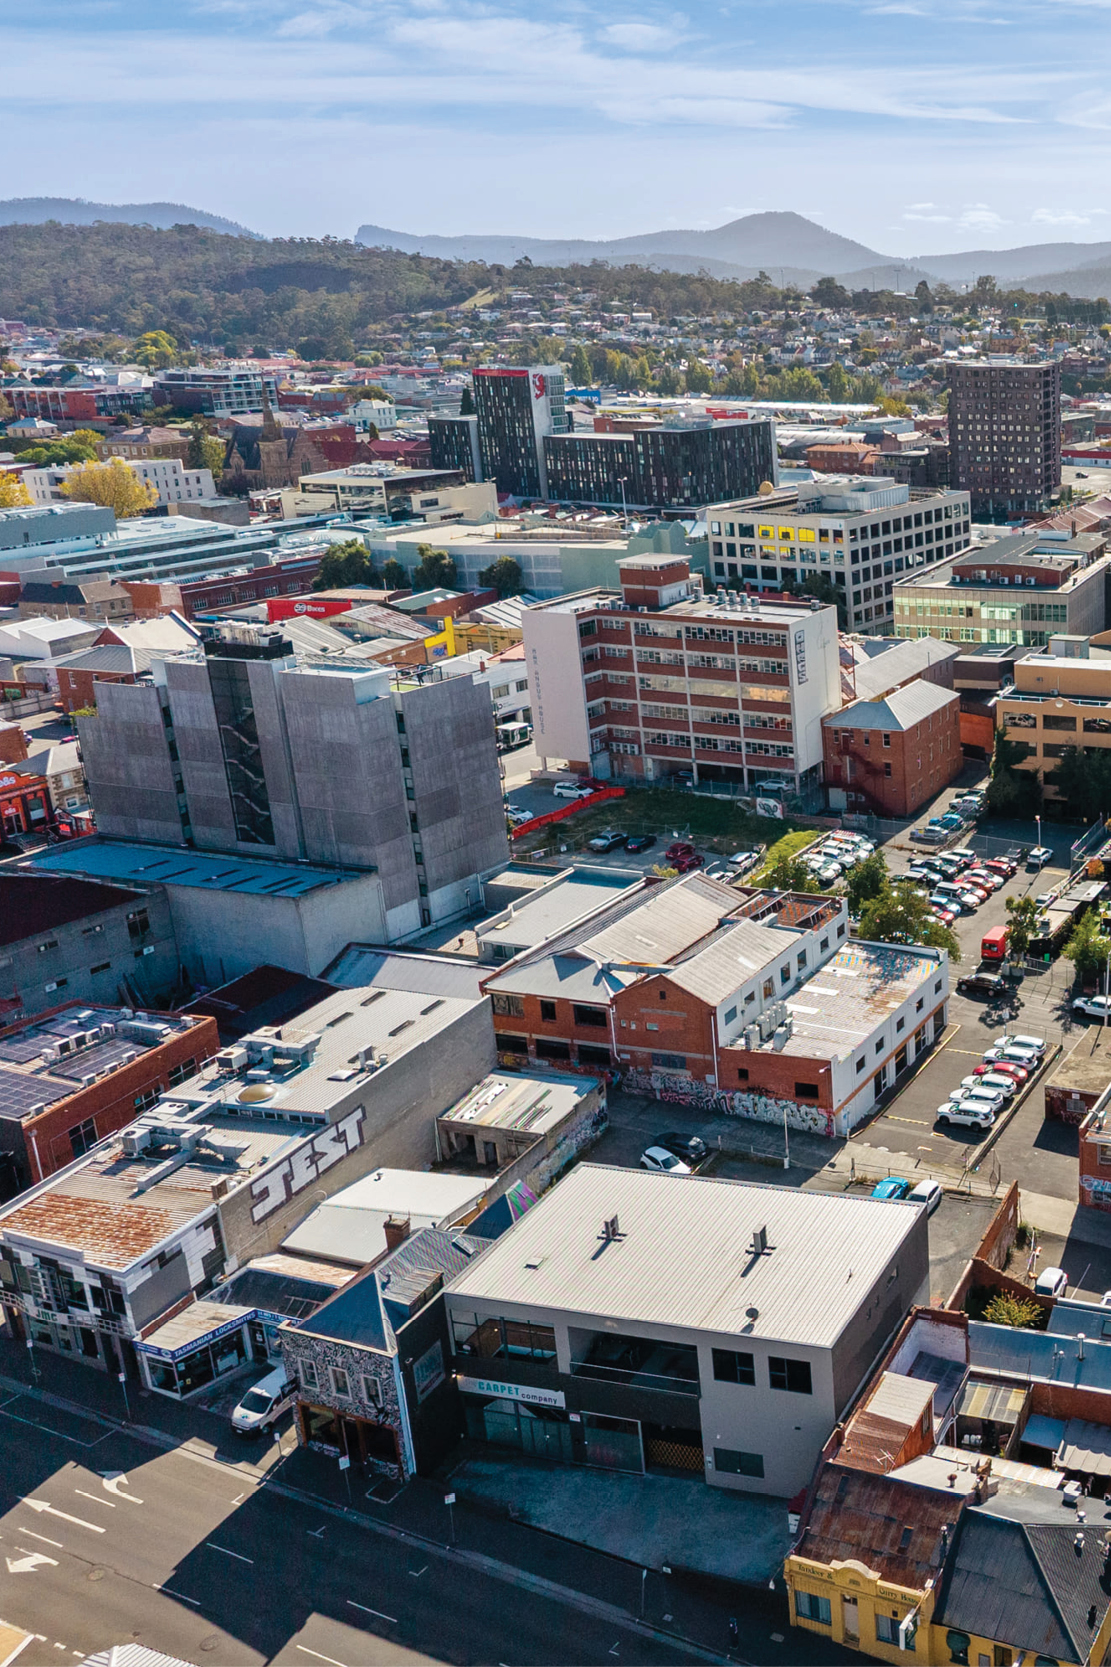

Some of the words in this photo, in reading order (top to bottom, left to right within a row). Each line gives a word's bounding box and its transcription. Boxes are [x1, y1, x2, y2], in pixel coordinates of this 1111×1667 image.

[174, 1333, 213, 1358] TASMANIAN
[215, 1312, 256, 1336] LOCKSMITHS
[478, 1381, 520, 1396] CARPET
[521, 1393, 558, 1405] company
